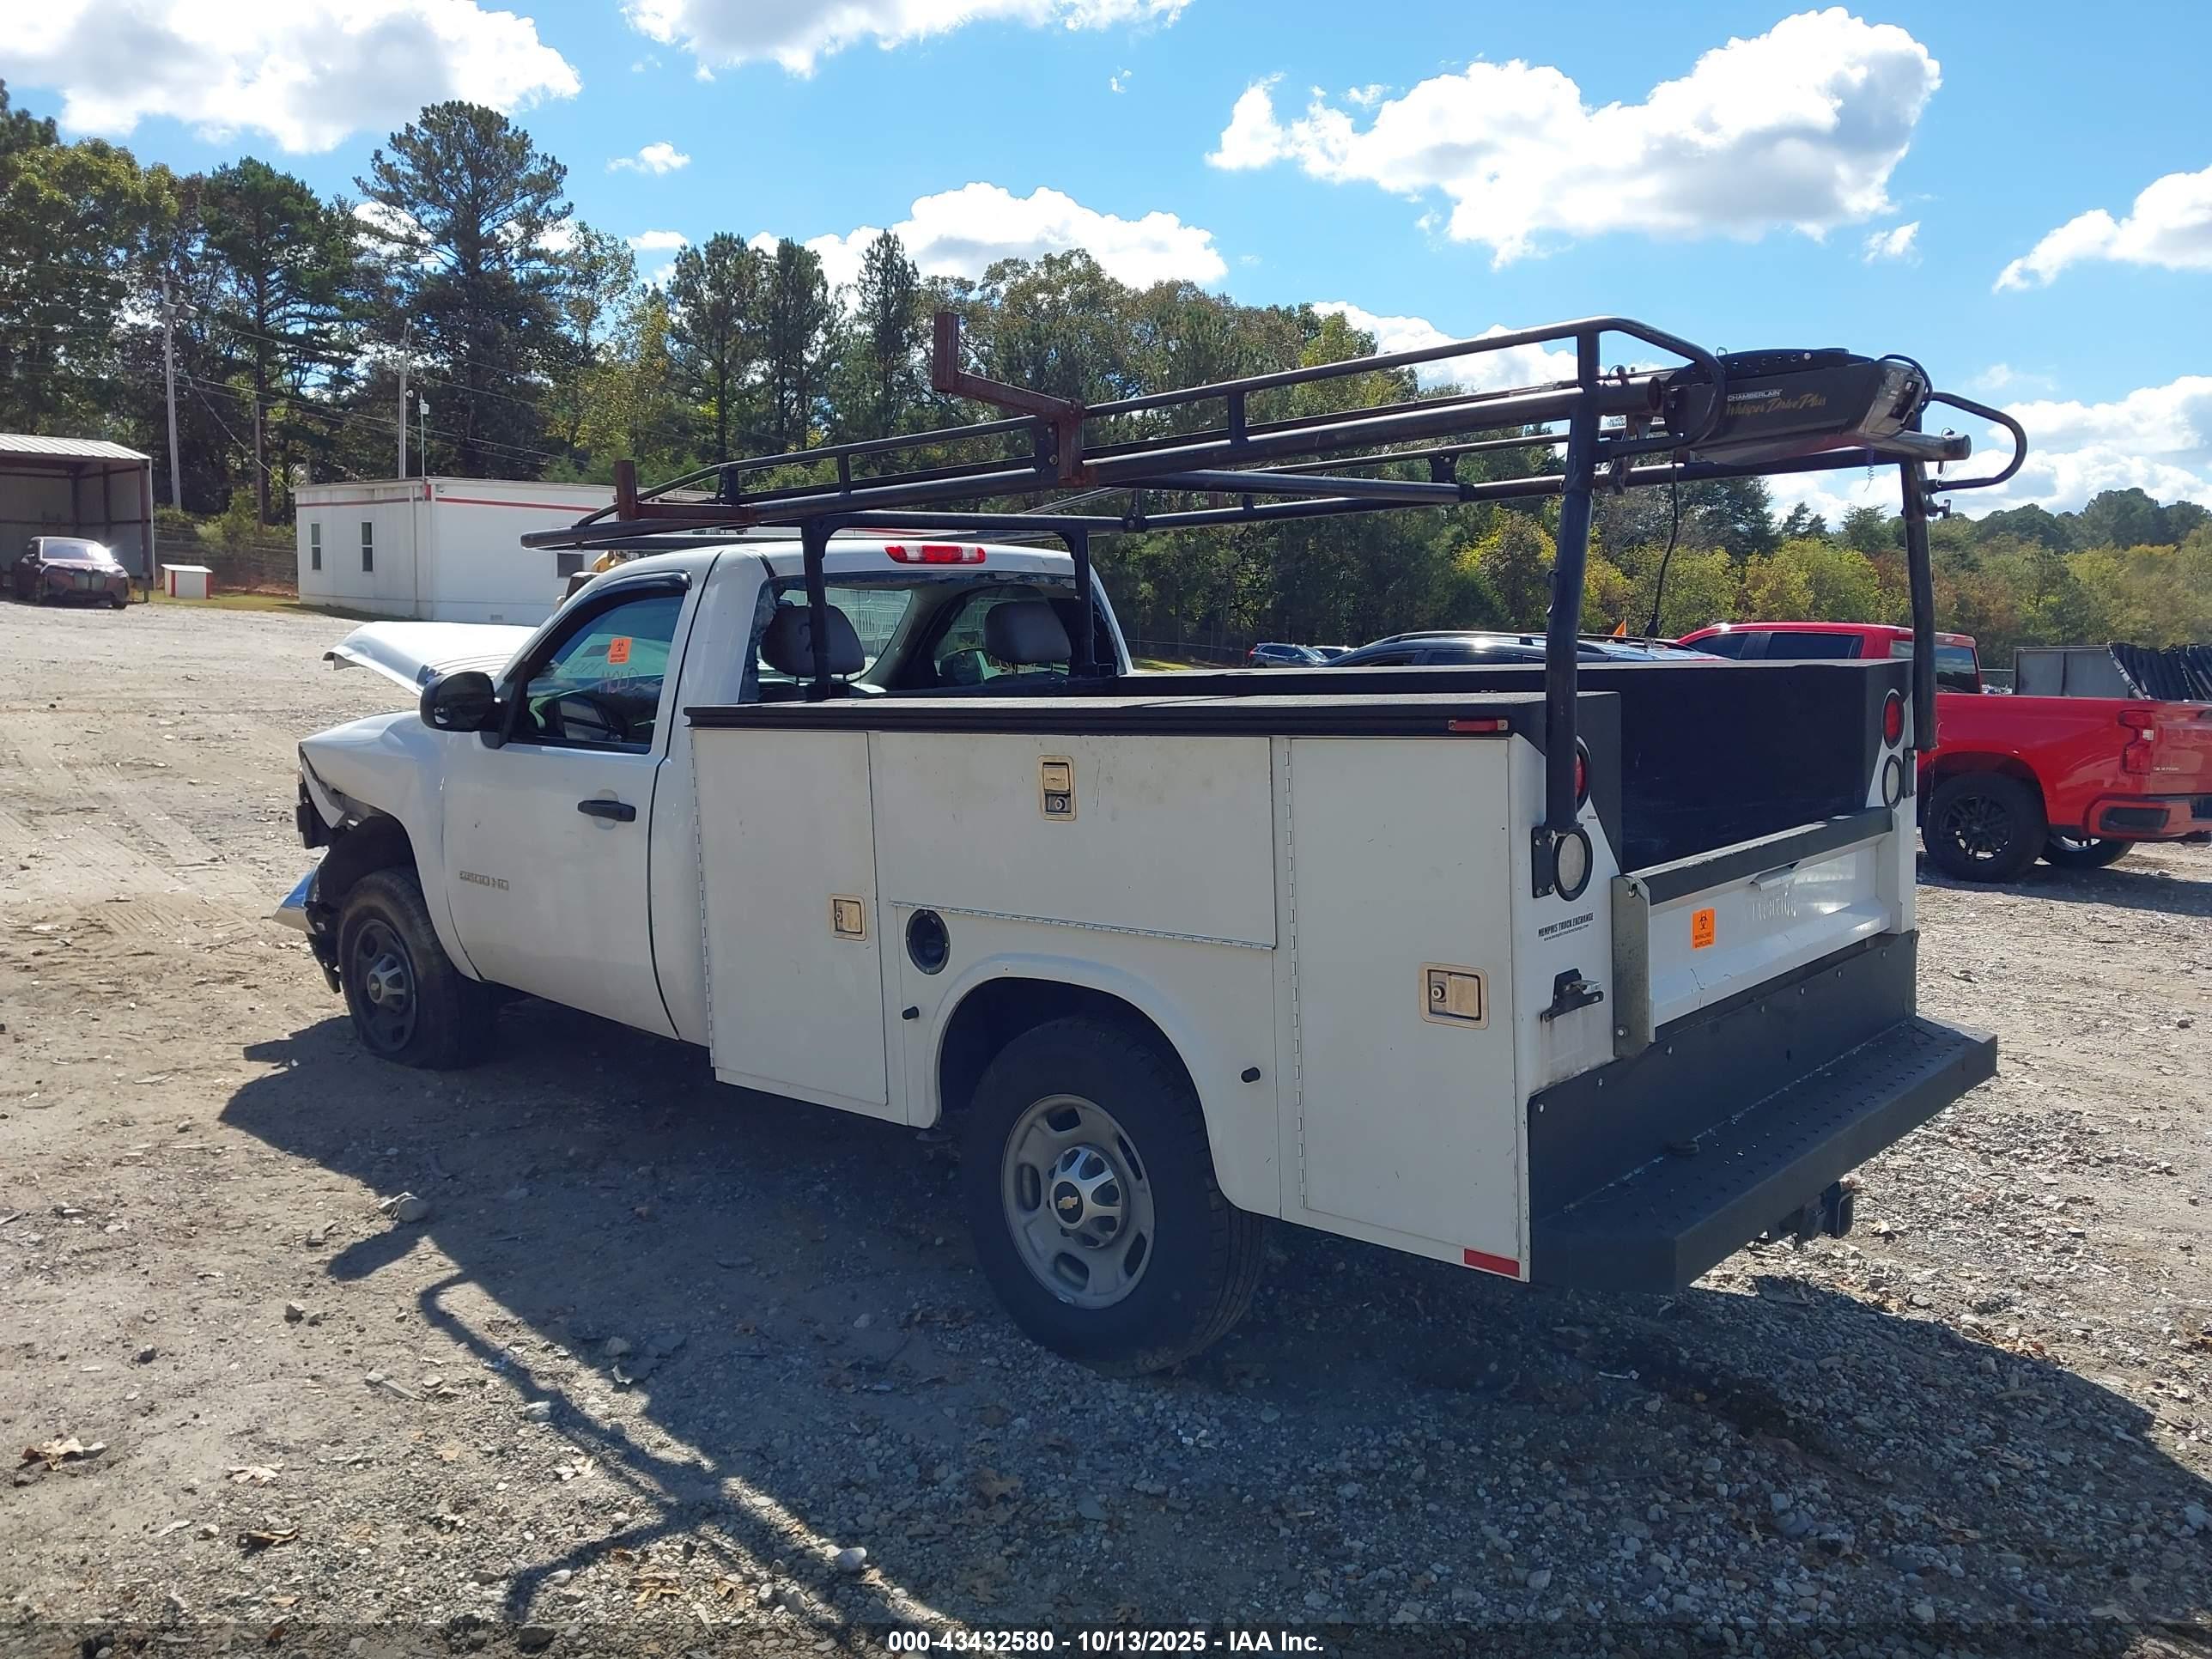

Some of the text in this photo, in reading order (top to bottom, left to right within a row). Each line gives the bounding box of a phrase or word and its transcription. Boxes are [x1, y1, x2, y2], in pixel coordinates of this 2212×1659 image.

[1727, 389, 1781, 402] CHAMBERLAIN
[1799, 392, 1827, 409] Plus
[1538, 912, 1594, 938] MEMPHIS TRUCK EXCHANGE
